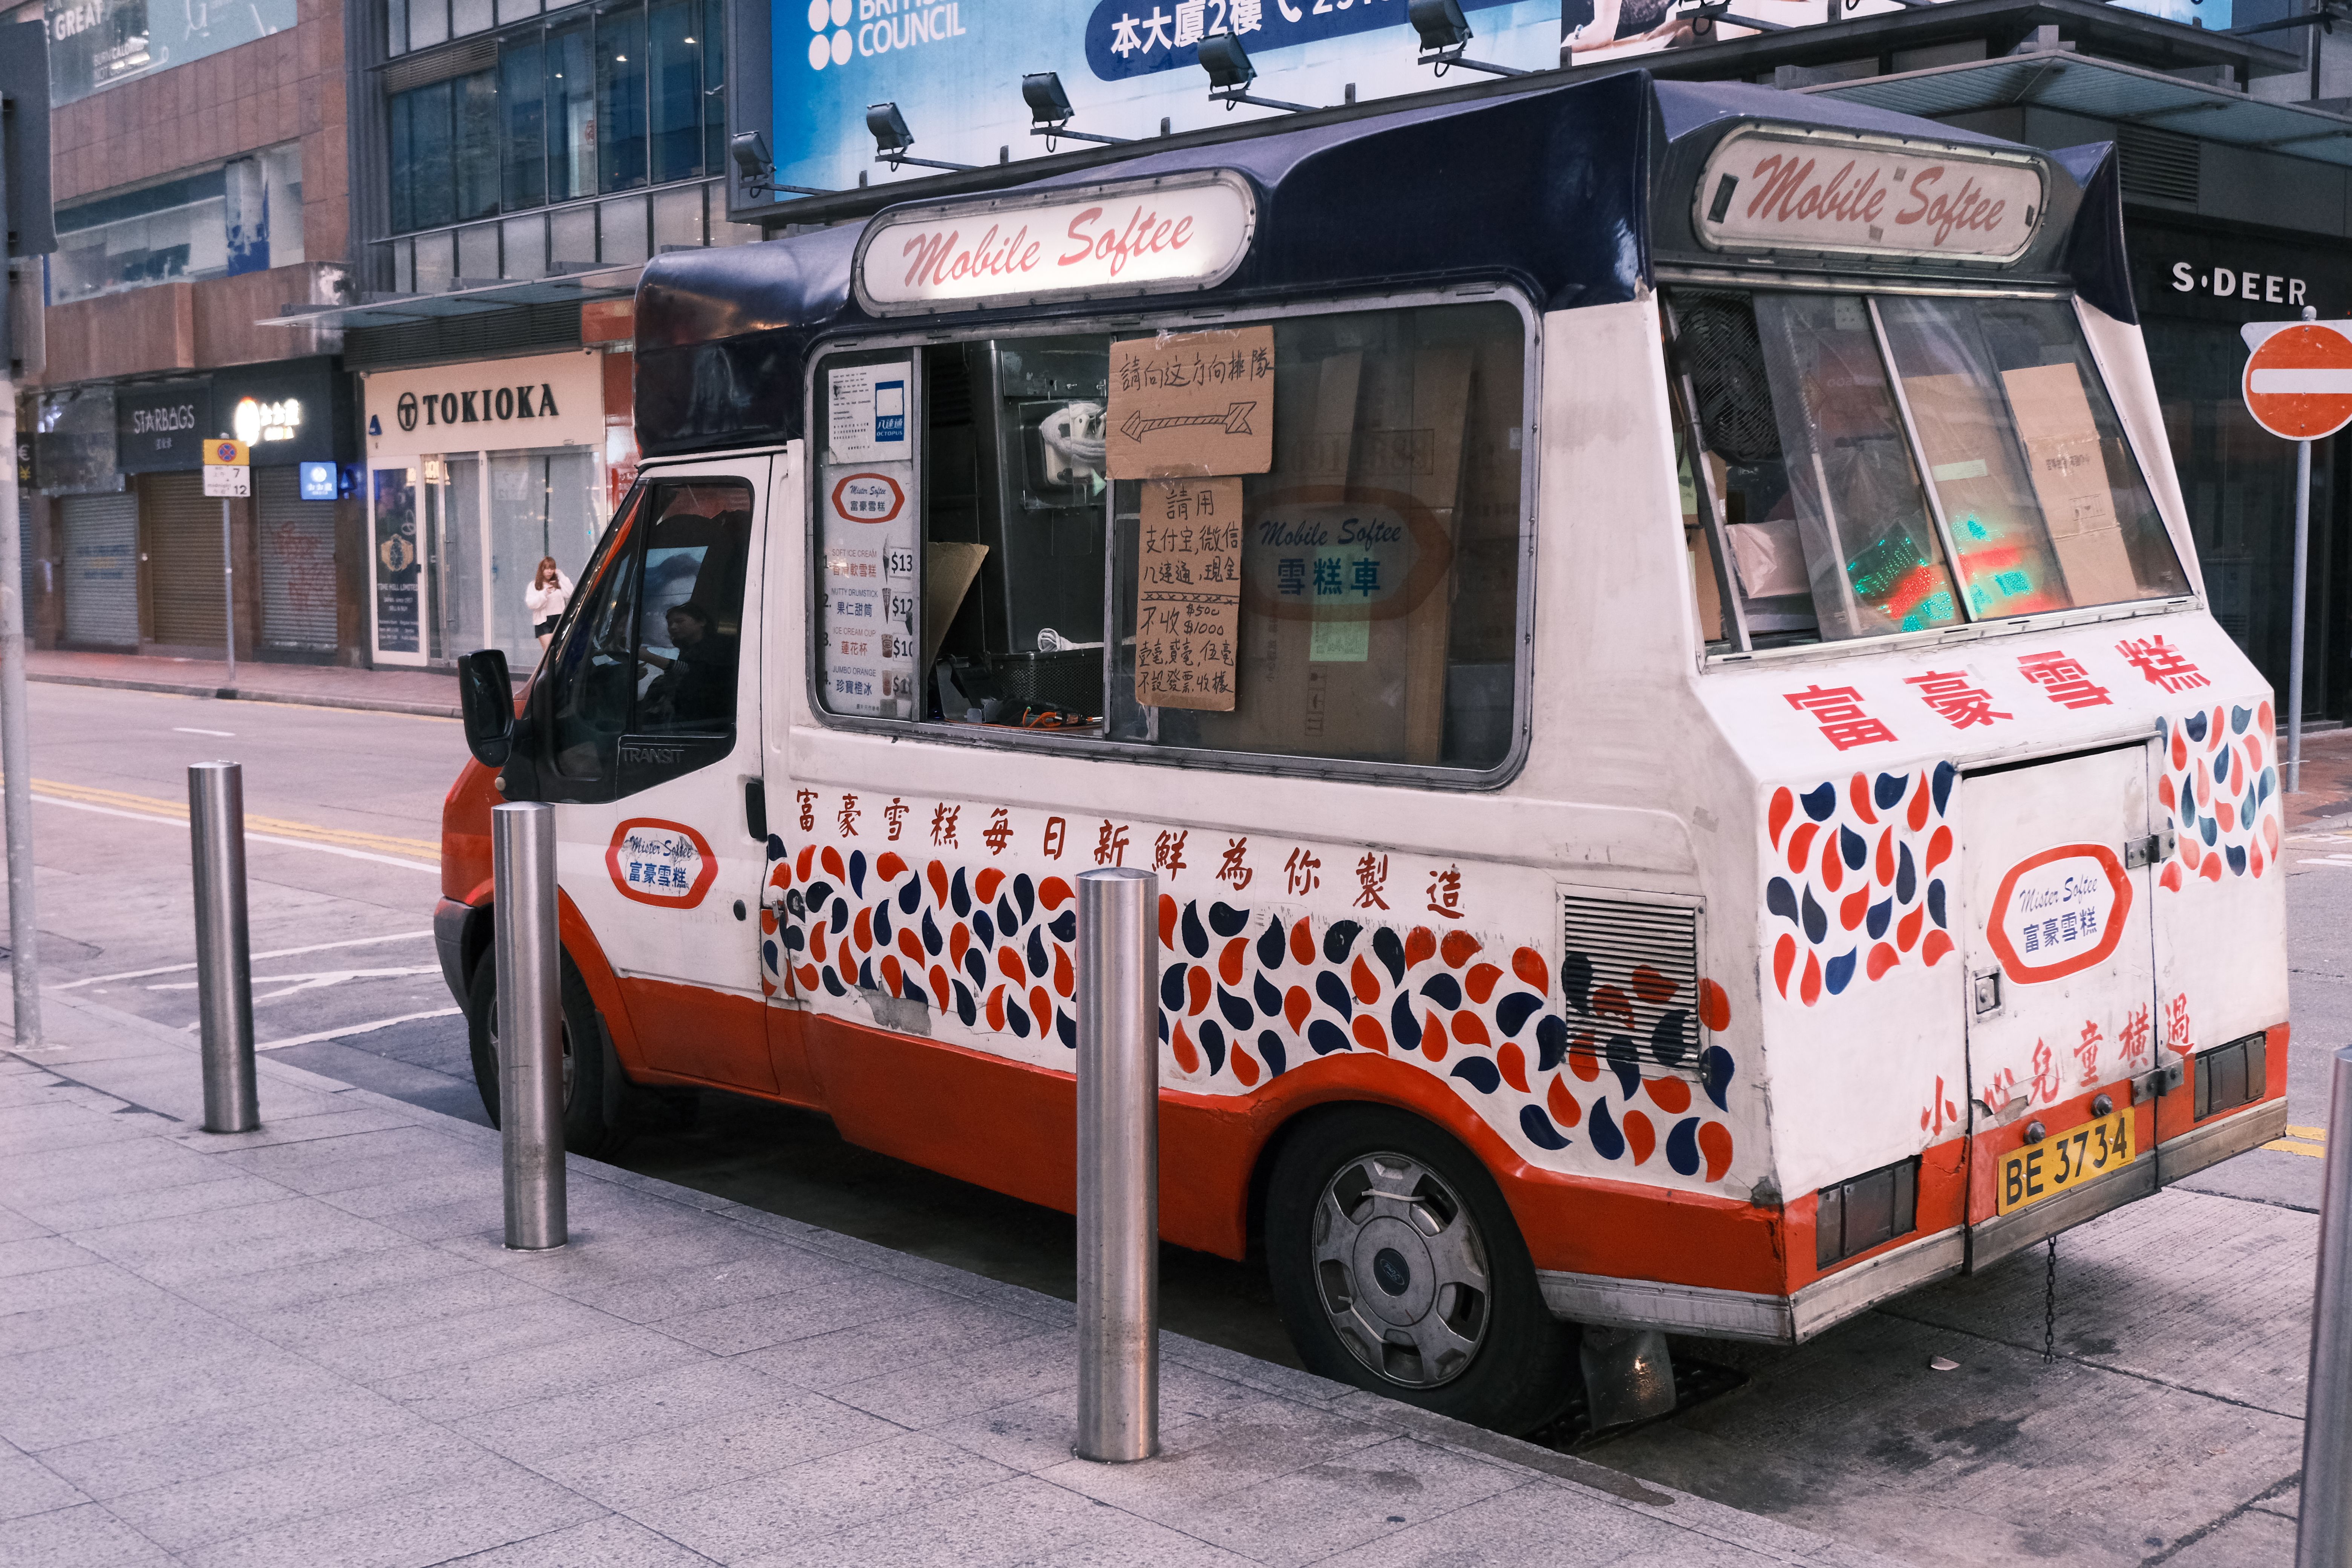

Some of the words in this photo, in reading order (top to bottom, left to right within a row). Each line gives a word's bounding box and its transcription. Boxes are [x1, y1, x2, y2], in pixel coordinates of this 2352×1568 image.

[858, 2, 966, 57] COUNCIL
[1746, 155, 1887, 224] Mobile
[1894, 165, 2005, 247] Softee
[902, 223, 1041, 288] Mobile
[1057, 204, 1194, 277] Softee
[423, 383, 560, 426] TOKIOKA
[877, 418, 903, 430] 八達通
[232, 468, 240, 479] 7
[234, 484, 247, 495] 12
[850, 485, 868, 495] Mister
[869, 486, 886, 498] Softee
[1166, 485, 1214, 520] 請用
[850, 501, 885, 511] 富豪雪糕
[1259, 519, 1328, 547] Mobile
[1337, 518, 1401, 551] Softee
[857, 549, 877, 558] CREAM
[891, 551, 913, 574] $13
[1277, 557, 1380, 597] 雪糕車
[831, 588, 848, 596] NUTTY
[848, 589, 878, 598] DRUMSTICK
[836, 602, 873, 617] 果仁甜筒
[1141, 606, 1180, 636] 不收
[843, 627, 863, 636] CREAM
[1184, 620, 1224, 636] $1000
[841, 640, 868, 656] 蓮花杯
[832, 666, 852, 674] JUMBO
[852, 667, 877, 677] ORANGE
[836, 679, 873, 696] 珍寶橙冰
[1782, 634, 2212, 752] 富豪雪糕
[621, 747, 685, 763] TRANSIT
[629, 835, 660, 855] Mister
[663, 839, 692, 862] Softee
[629, 860, 687, 888] 富豪雪糕
[2019, 888, 2059, 913] Mister
[2063, 874, 2098, 905] Softee
[2023, 906, 2098, 953] 富豪雪糕
[2005, 1150, 2044, 1206] BE
[2054, 1116, 2128, 1185] 3734
